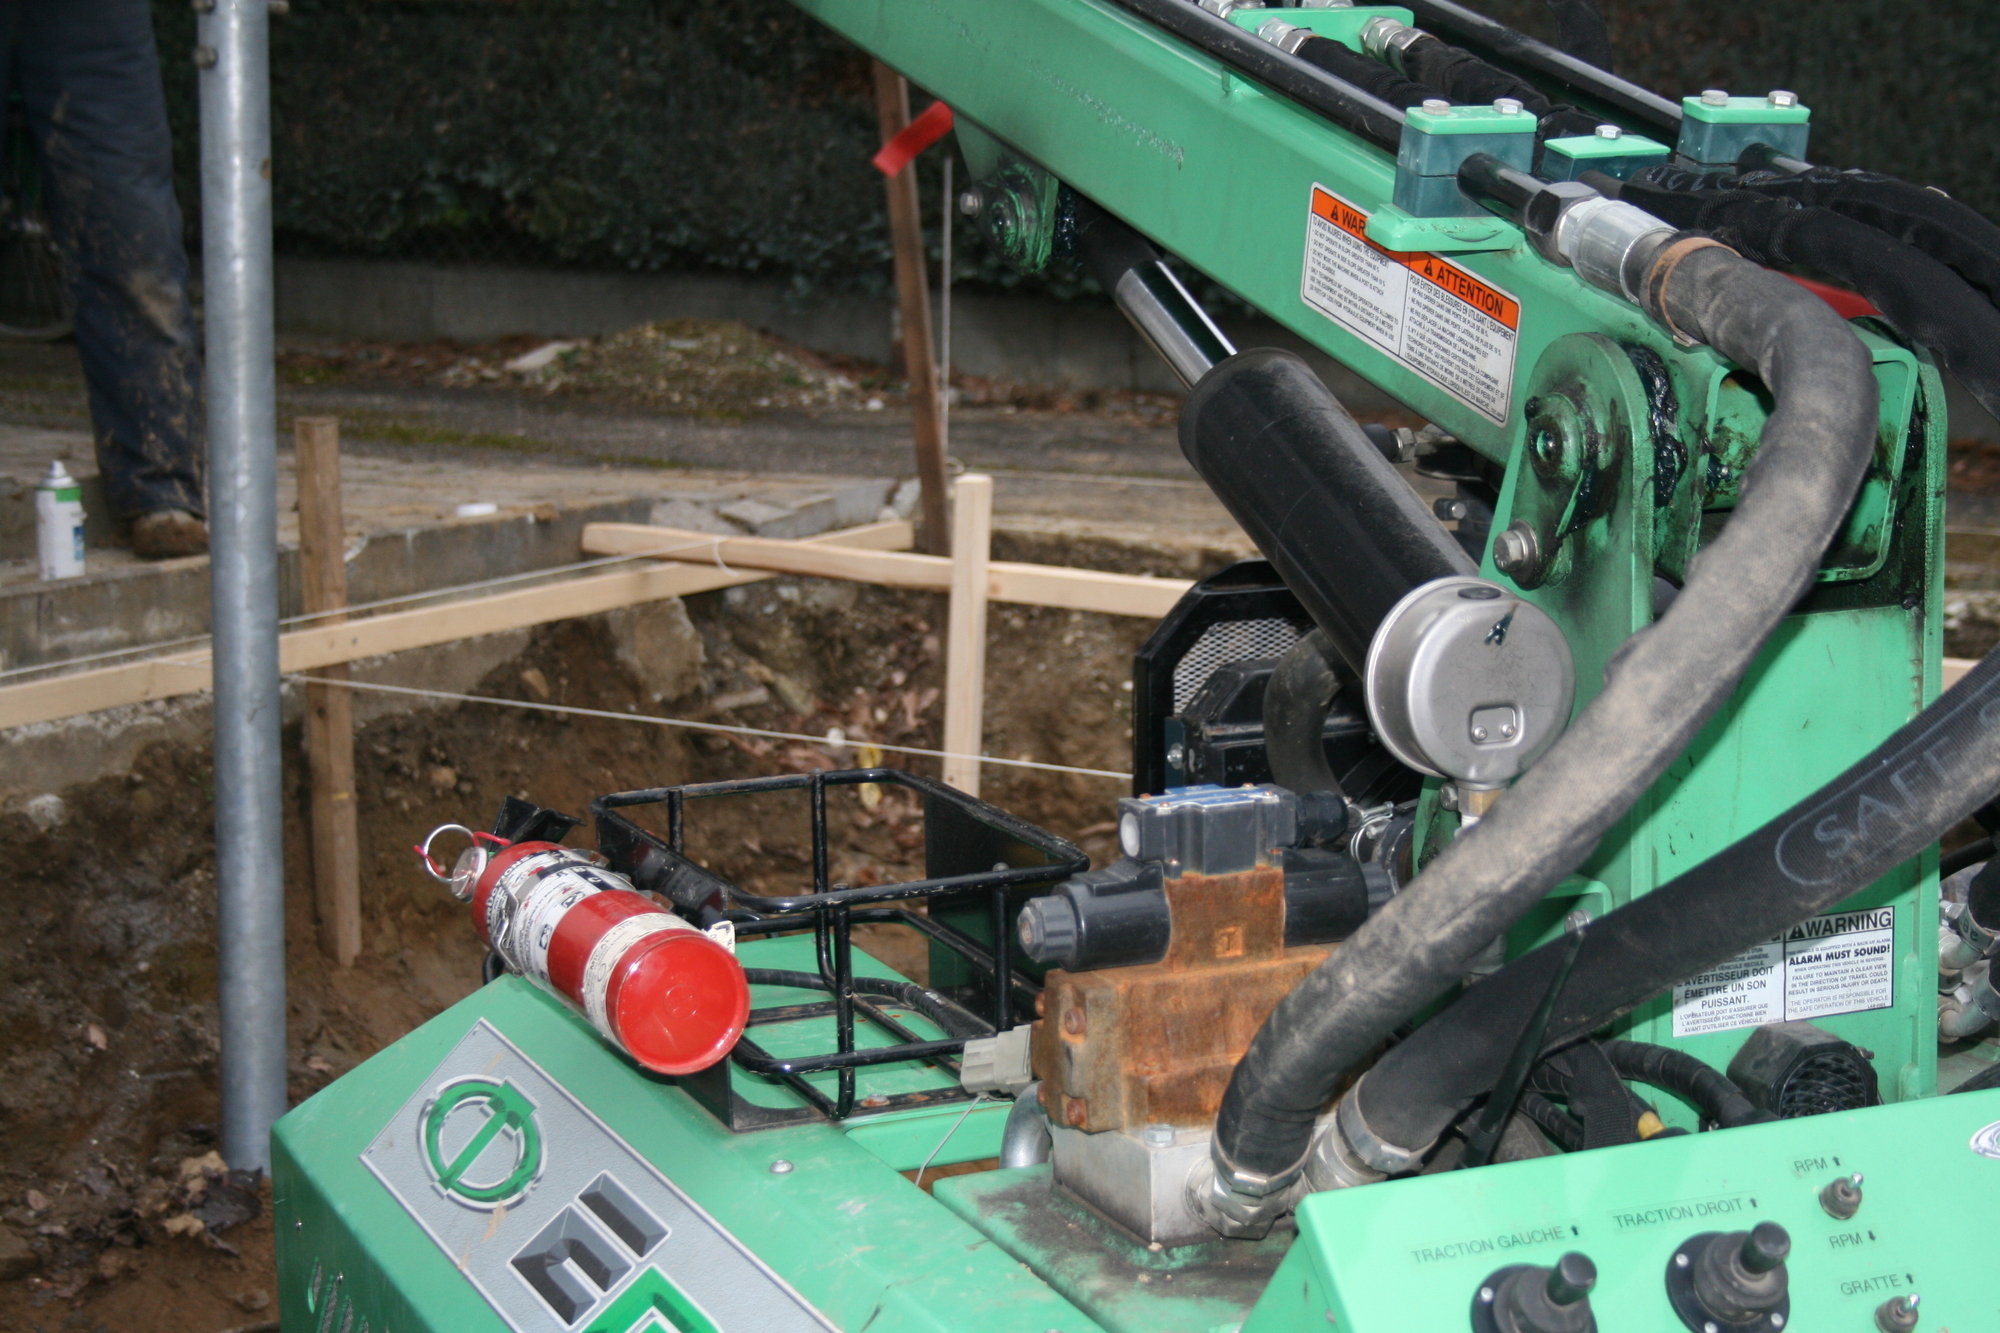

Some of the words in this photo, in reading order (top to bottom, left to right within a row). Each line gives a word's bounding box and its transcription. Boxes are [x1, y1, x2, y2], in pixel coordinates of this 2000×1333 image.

[1436, 265, 1504, 318] ATTENTION
[1805, 911, 1892, 937] WARNING
[1788, 953, 1821, 965] ALARM
[1825, 949, 1851, 960] MUST
[1853, 944, 1890, 957] SOUND!
[1751, 964, 1773, 976] DOIT
[1824, 968, 1849, 976] MAINTAIN
[1684, 982, 1727, 998] ÉMETTRE
[1731, 982, 1743, 992] UN
[1746, 978, 1766, 990] SON
[1809, 977, 1838, 985] DIRECTION
[1816, 983, 1839, 991] SERIOUS
[1701, 994, 1749, 1009] PUISSANT.
[1802, 995, 1831, 1004] OPERATOR
[1838, 989, 1873, 999] RESPONSIBLE
[1813, 1001, 1843, 1010] OPERATION
[1866, 995, 1887, 1003] VEHICLE
[1721, 1011, 1753, 1020] FONCTIONNE
[1794, 1157, 1828, 1173] RPM
[1612, 1205, 1694, 1229] TRACTION
[1696, 1197, 1742, 1217] DROIT
[1411, 1238, 1495, 1264] TRACTION
[1497, 1225, 1566, 1250] GAUCHE
[1829, 1229, 1864, 1249] RPM
[1840, 1273, 1902, 1297] GRATTE
